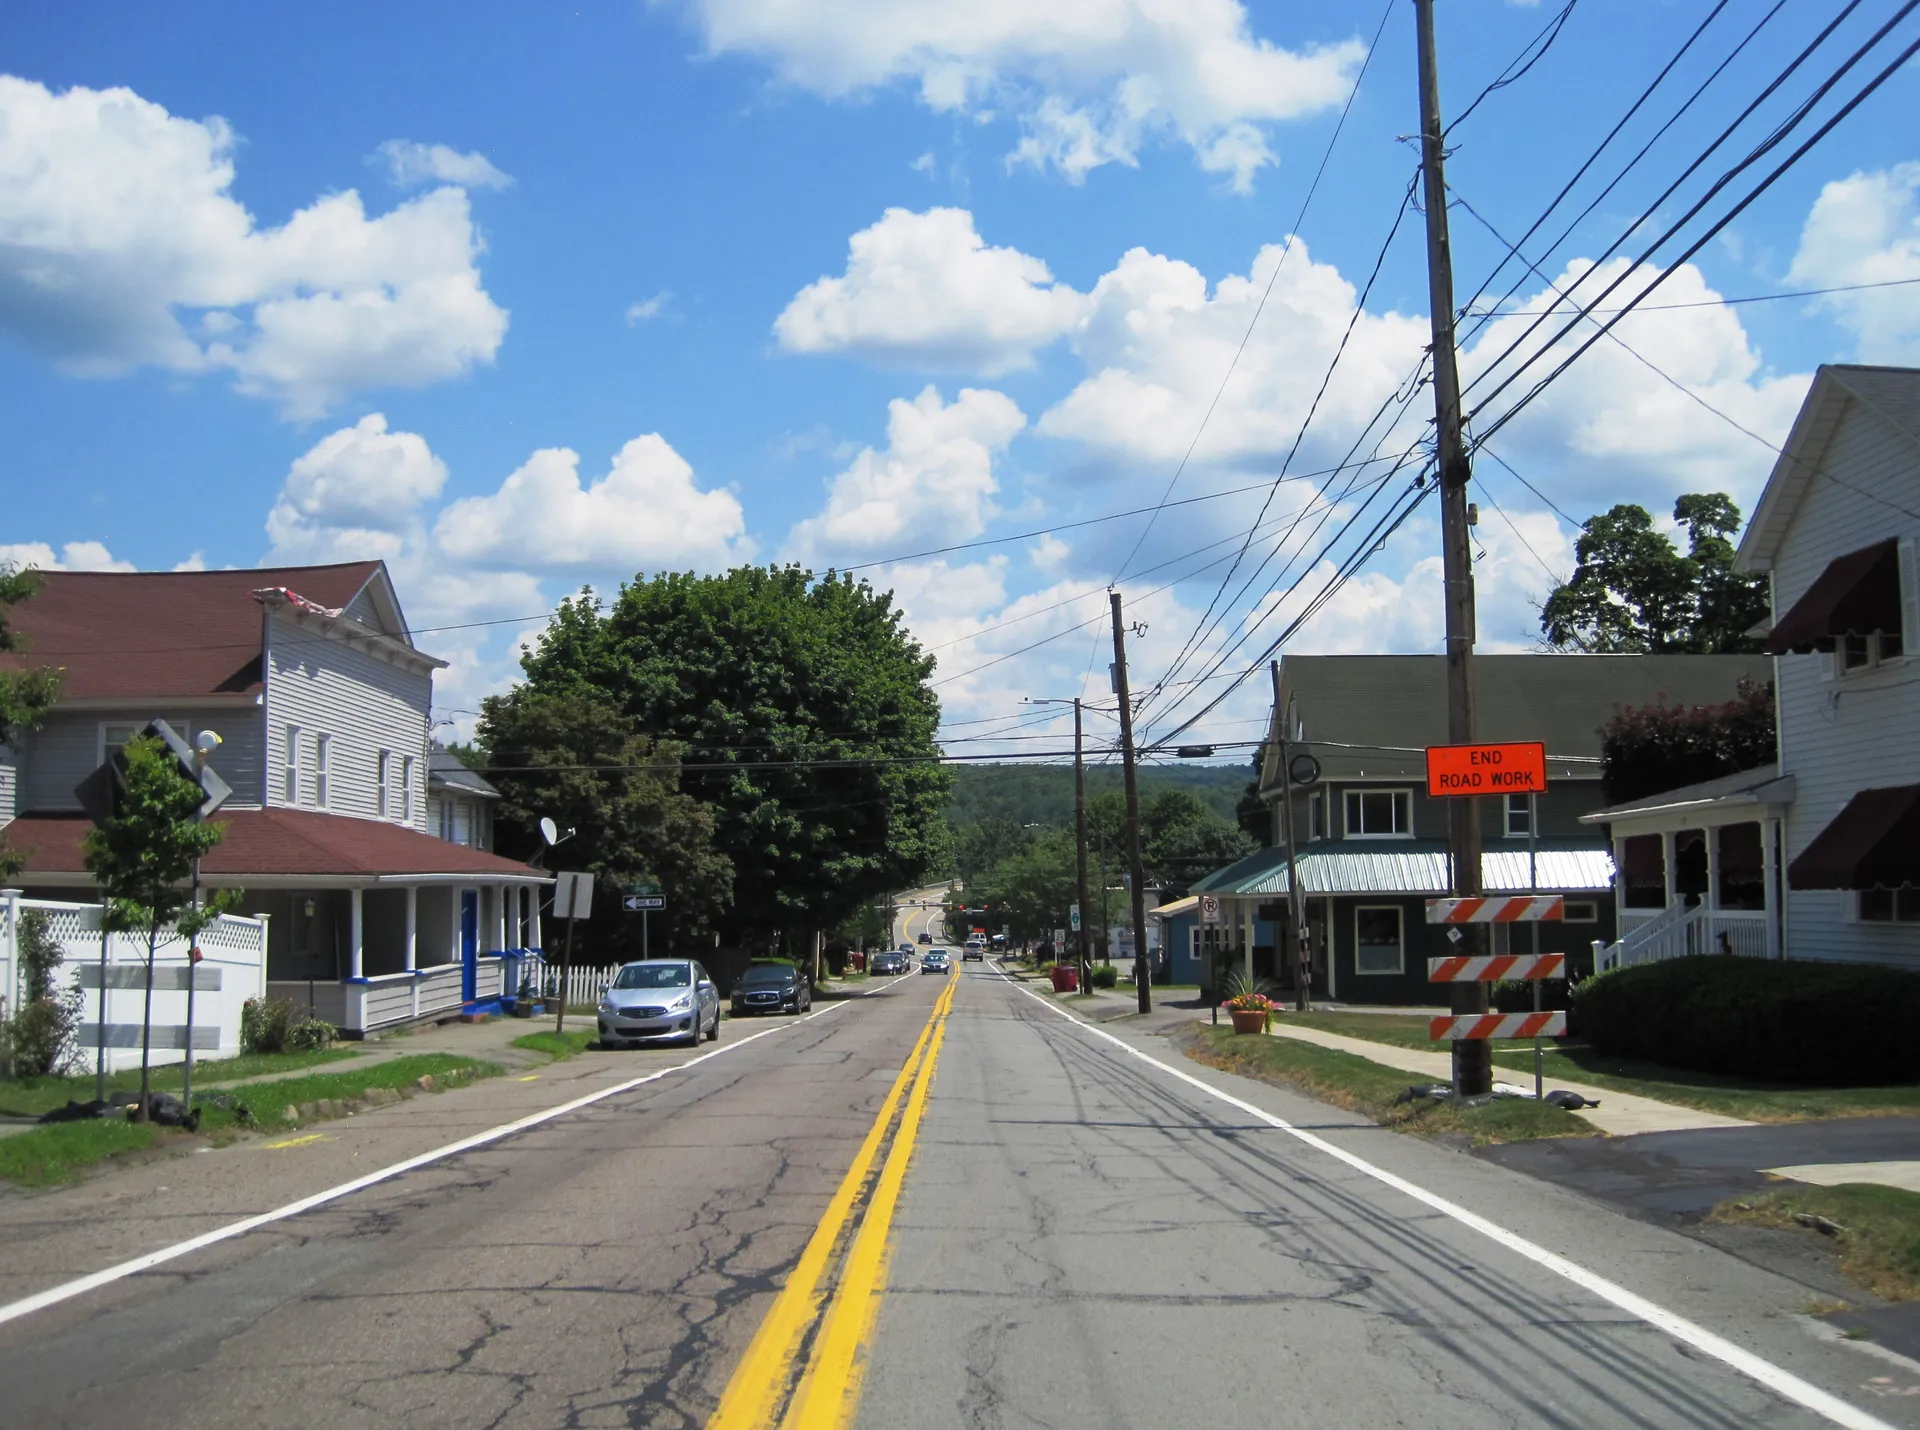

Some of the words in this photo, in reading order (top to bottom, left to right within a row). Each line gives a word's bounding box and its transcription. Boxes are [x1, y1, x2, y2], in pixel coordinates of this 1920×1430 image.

[1470, 751, 1502, 765] END
[1440, 773, 1482, 788] ROAD
[1491, 771, 1534, 785] WORK
